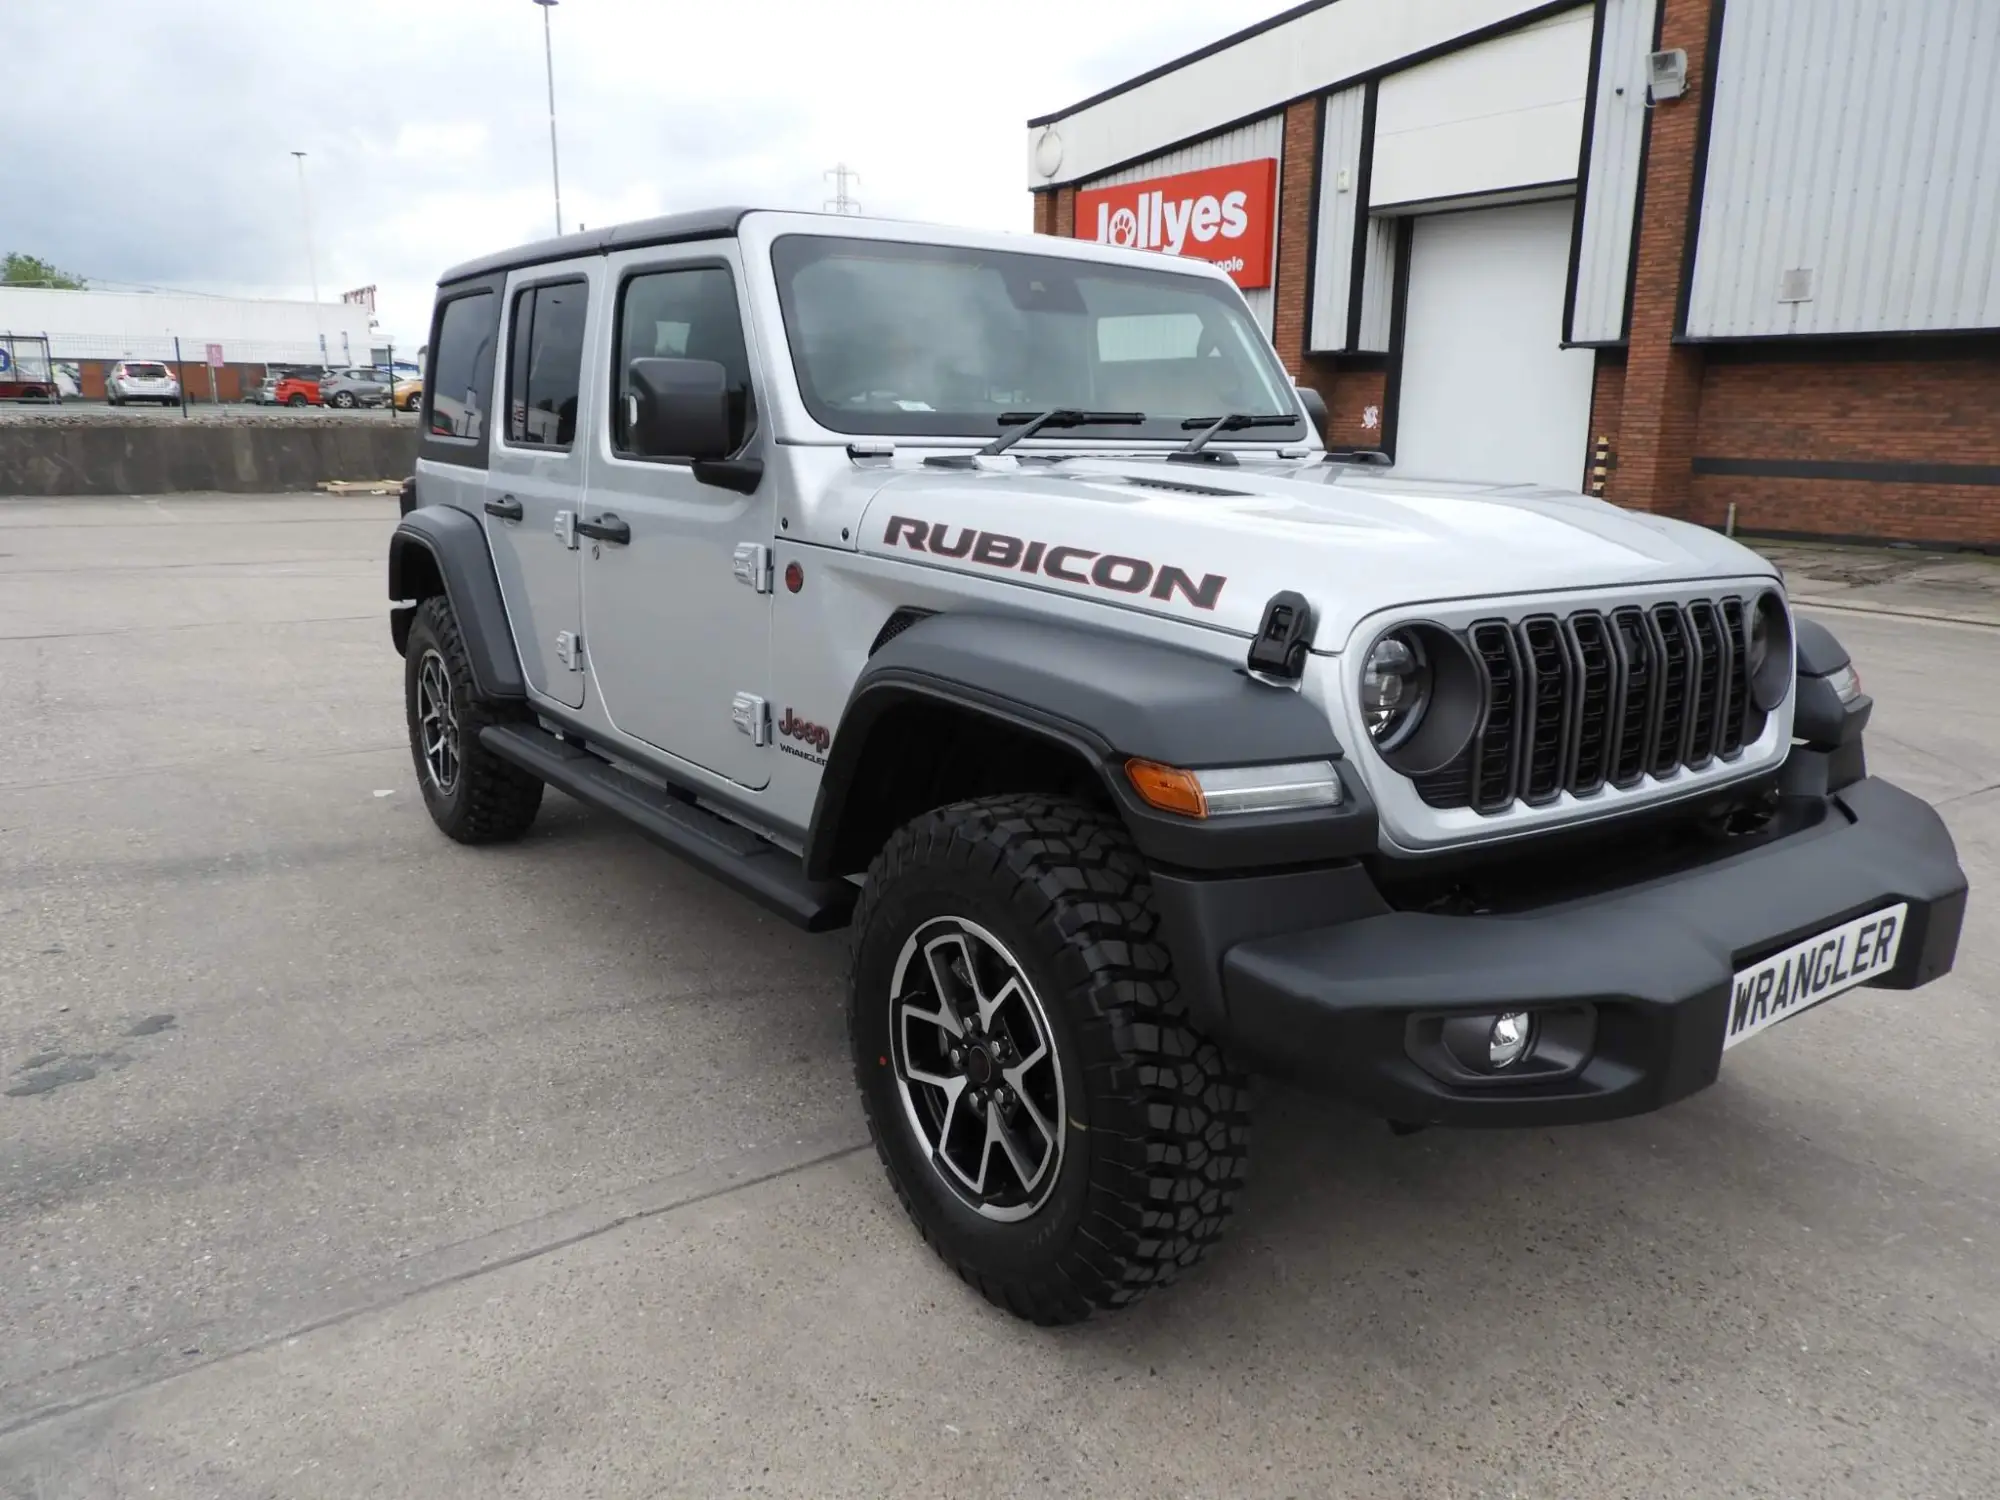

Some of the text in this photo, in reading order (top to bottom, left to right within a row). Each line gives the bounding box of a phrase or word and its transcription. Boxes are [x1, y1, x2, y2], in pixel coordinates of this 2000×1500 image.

[1096, 190, 1248, 255] Jollyes
[1213, 256, 1244, 272] ople
[883, 515, 1227, 611] RUBICON
[778, 707, 830, 754] Jeep
[1730, 916, 1897, 1036] WRANGLER
